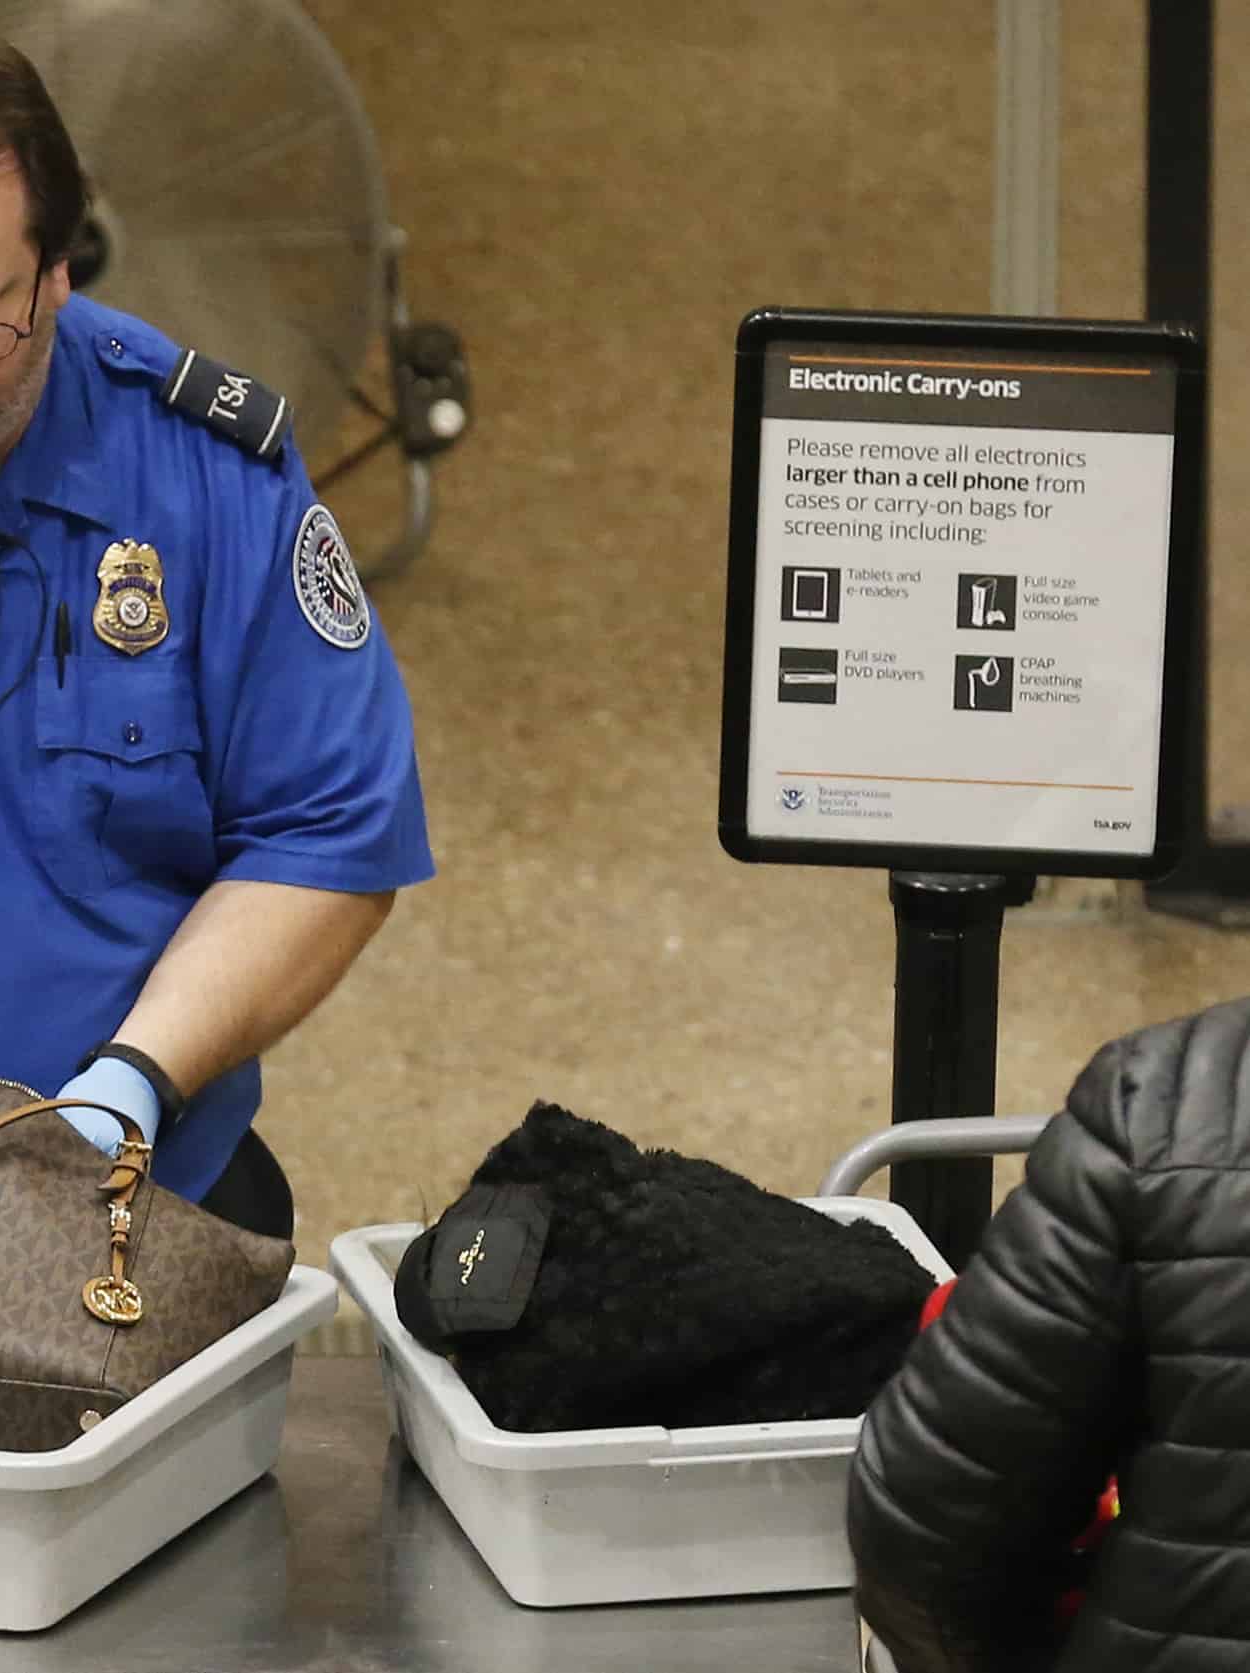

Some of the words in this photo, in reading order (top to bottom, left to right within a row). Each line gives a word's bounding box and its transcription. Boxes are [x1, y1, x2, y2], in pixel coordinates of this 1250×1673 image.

[790, 368, 902, 393] Electronic
[906, 373, 1021, 400] Carry-ons
[207, 373, 252, 420] TSA
[787, 438, 853, 459] Please
[859, 445, 939, 462] remove
[945, 444, 969, 463] all
[975, 446, 1087, 468] electronics
[786, 464, 848, 486] larger
[853, 467, 900, 487] than
[906, 473, 917, 488] a
[923, 471, 957, 489] cell
[963, 472, 1029, 493] phone
[1036, 474, 1086, 494] from
[785, 494, 840, 511] cases
[846, 496, 868, 511] or
[874, 498, 963, 518] carry-on
[969, 498, 1017, 520] bags
[1023, 500, 1053, 519] for
[784, 519, 883, 541] screening
[889, 521, 987, 546] including:
[848, 568, 893, 582] Tablets
[896, 571, 921, 583] and
[1024, 576, 1047, 588] Full
[1051, 577, 1076, 589] size
[847, 586, 909, 599] e-readers
[1023, 593, 1060, 605] video
[1063, 595, 1100, 607] game
[1022, 609, 1079, 622] consoles
[845, 650, 868, 662] Full
[871, 651, 896, 663] size
[1020, 657, 1055, 669] CPAP
[844, 666, 873, 678] DVD
[876, 667, 925, 681] players
[1019, 673, 1083, 689] breathing
[1018, 690, 1081, 704] machines
